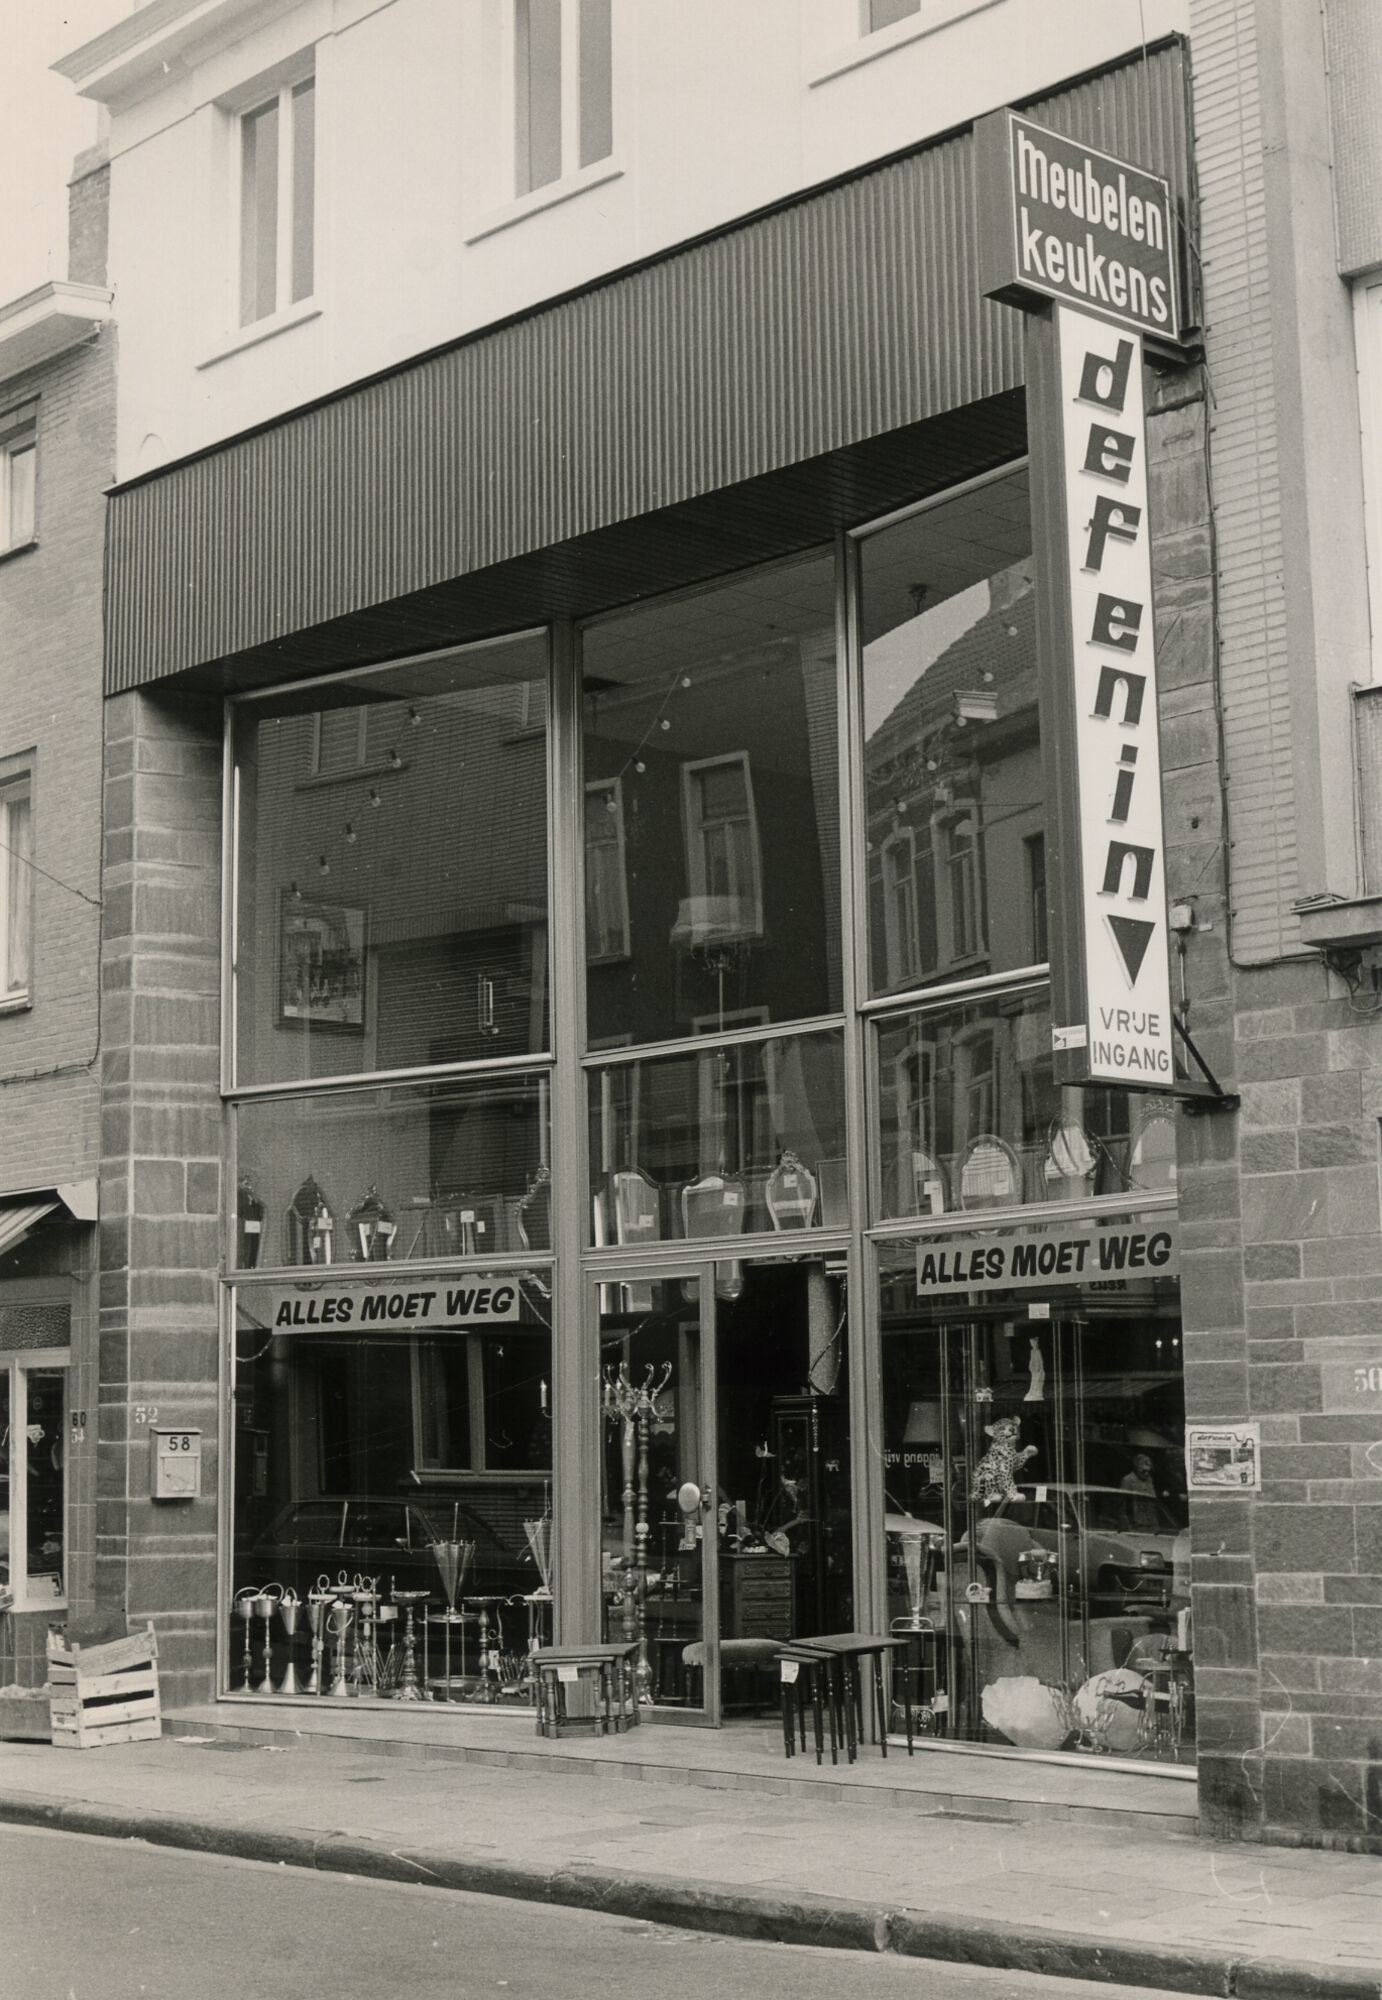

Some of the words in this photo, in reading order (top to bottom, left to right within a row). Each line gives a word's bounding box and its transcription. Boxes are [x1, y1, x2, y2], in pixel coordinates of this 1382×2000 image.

[1017, 129, 1163, 250] meubelen
[1021, 206, 1168, 323] keukens
[1099, 1006, 1160, 1037] VRIJE
[1093, 1041, 1169, 1073] INGANG
[920, 1246, 1006, 1286] ALLES
[1010, 1239, 1091, 1277] MOET
[1099, 1232, 1173, 1271] WEG
[275, 1297, 354, 1327] ALLES
[360, 1291, 436, 1321] MOET
[446, 1286, 515, 1317] WEG
[72, 1411, 87, 1428] 60
[135, 1407, 159, 1424] 52
[168, 1436, 191, 1451] 58
